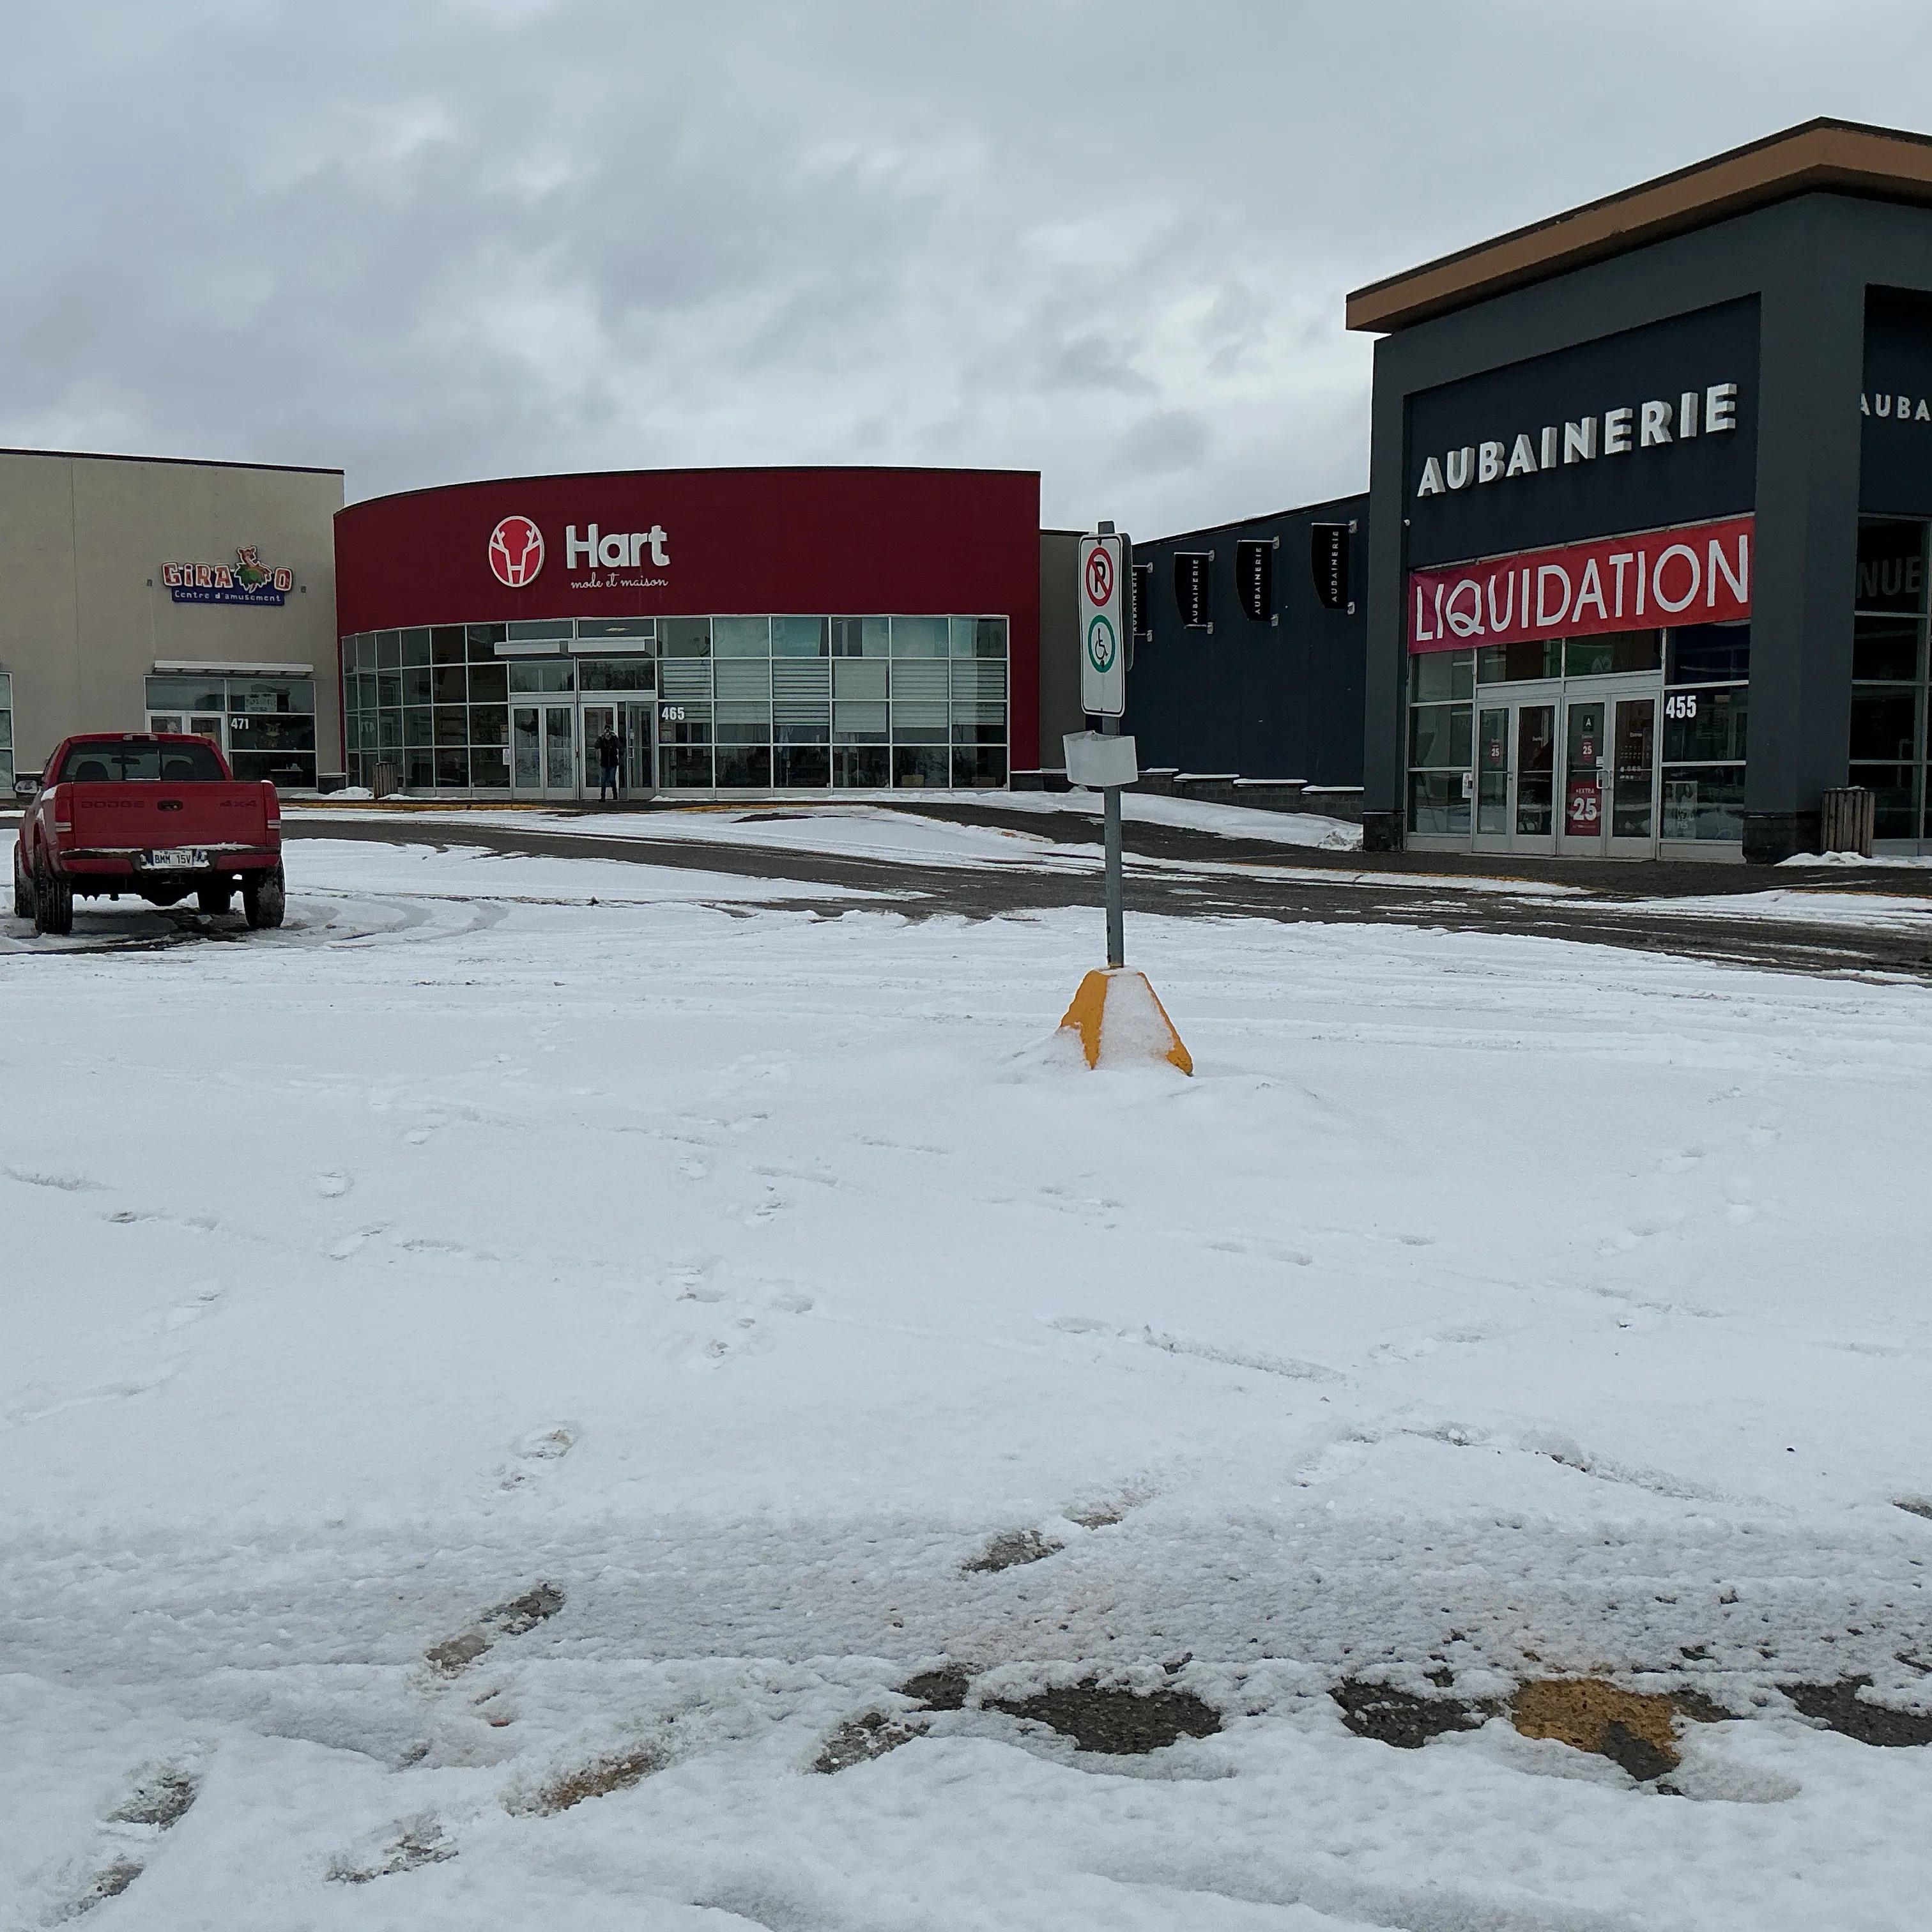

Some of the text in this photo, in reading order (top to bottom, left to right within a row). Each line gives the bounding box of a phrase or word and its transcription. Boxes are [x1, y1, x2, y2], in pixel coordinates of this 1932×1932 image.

[1417, 383, 1737, 498] AUBAINERIE
[566, 523, 670, 569] Hart
[1331, 531, 1339, 602] AUBAINERIE
[571, 571, 669, 589] mode et maison
[1416, 534, 1749, 641] LIQUIDATION
[174, 590, 282, 602] Centre d'amusement
[661, 706, 685, 721] 465
[1666, 695, 1697, 719] 455
[231, 717, 249, 730] 471
[1491, 747, 1499, 757] 25
[1583, 745, 1592, 755] 25
[80, 800, 146, 809] DODGE
[1573, 797, 1597, 821] 25
